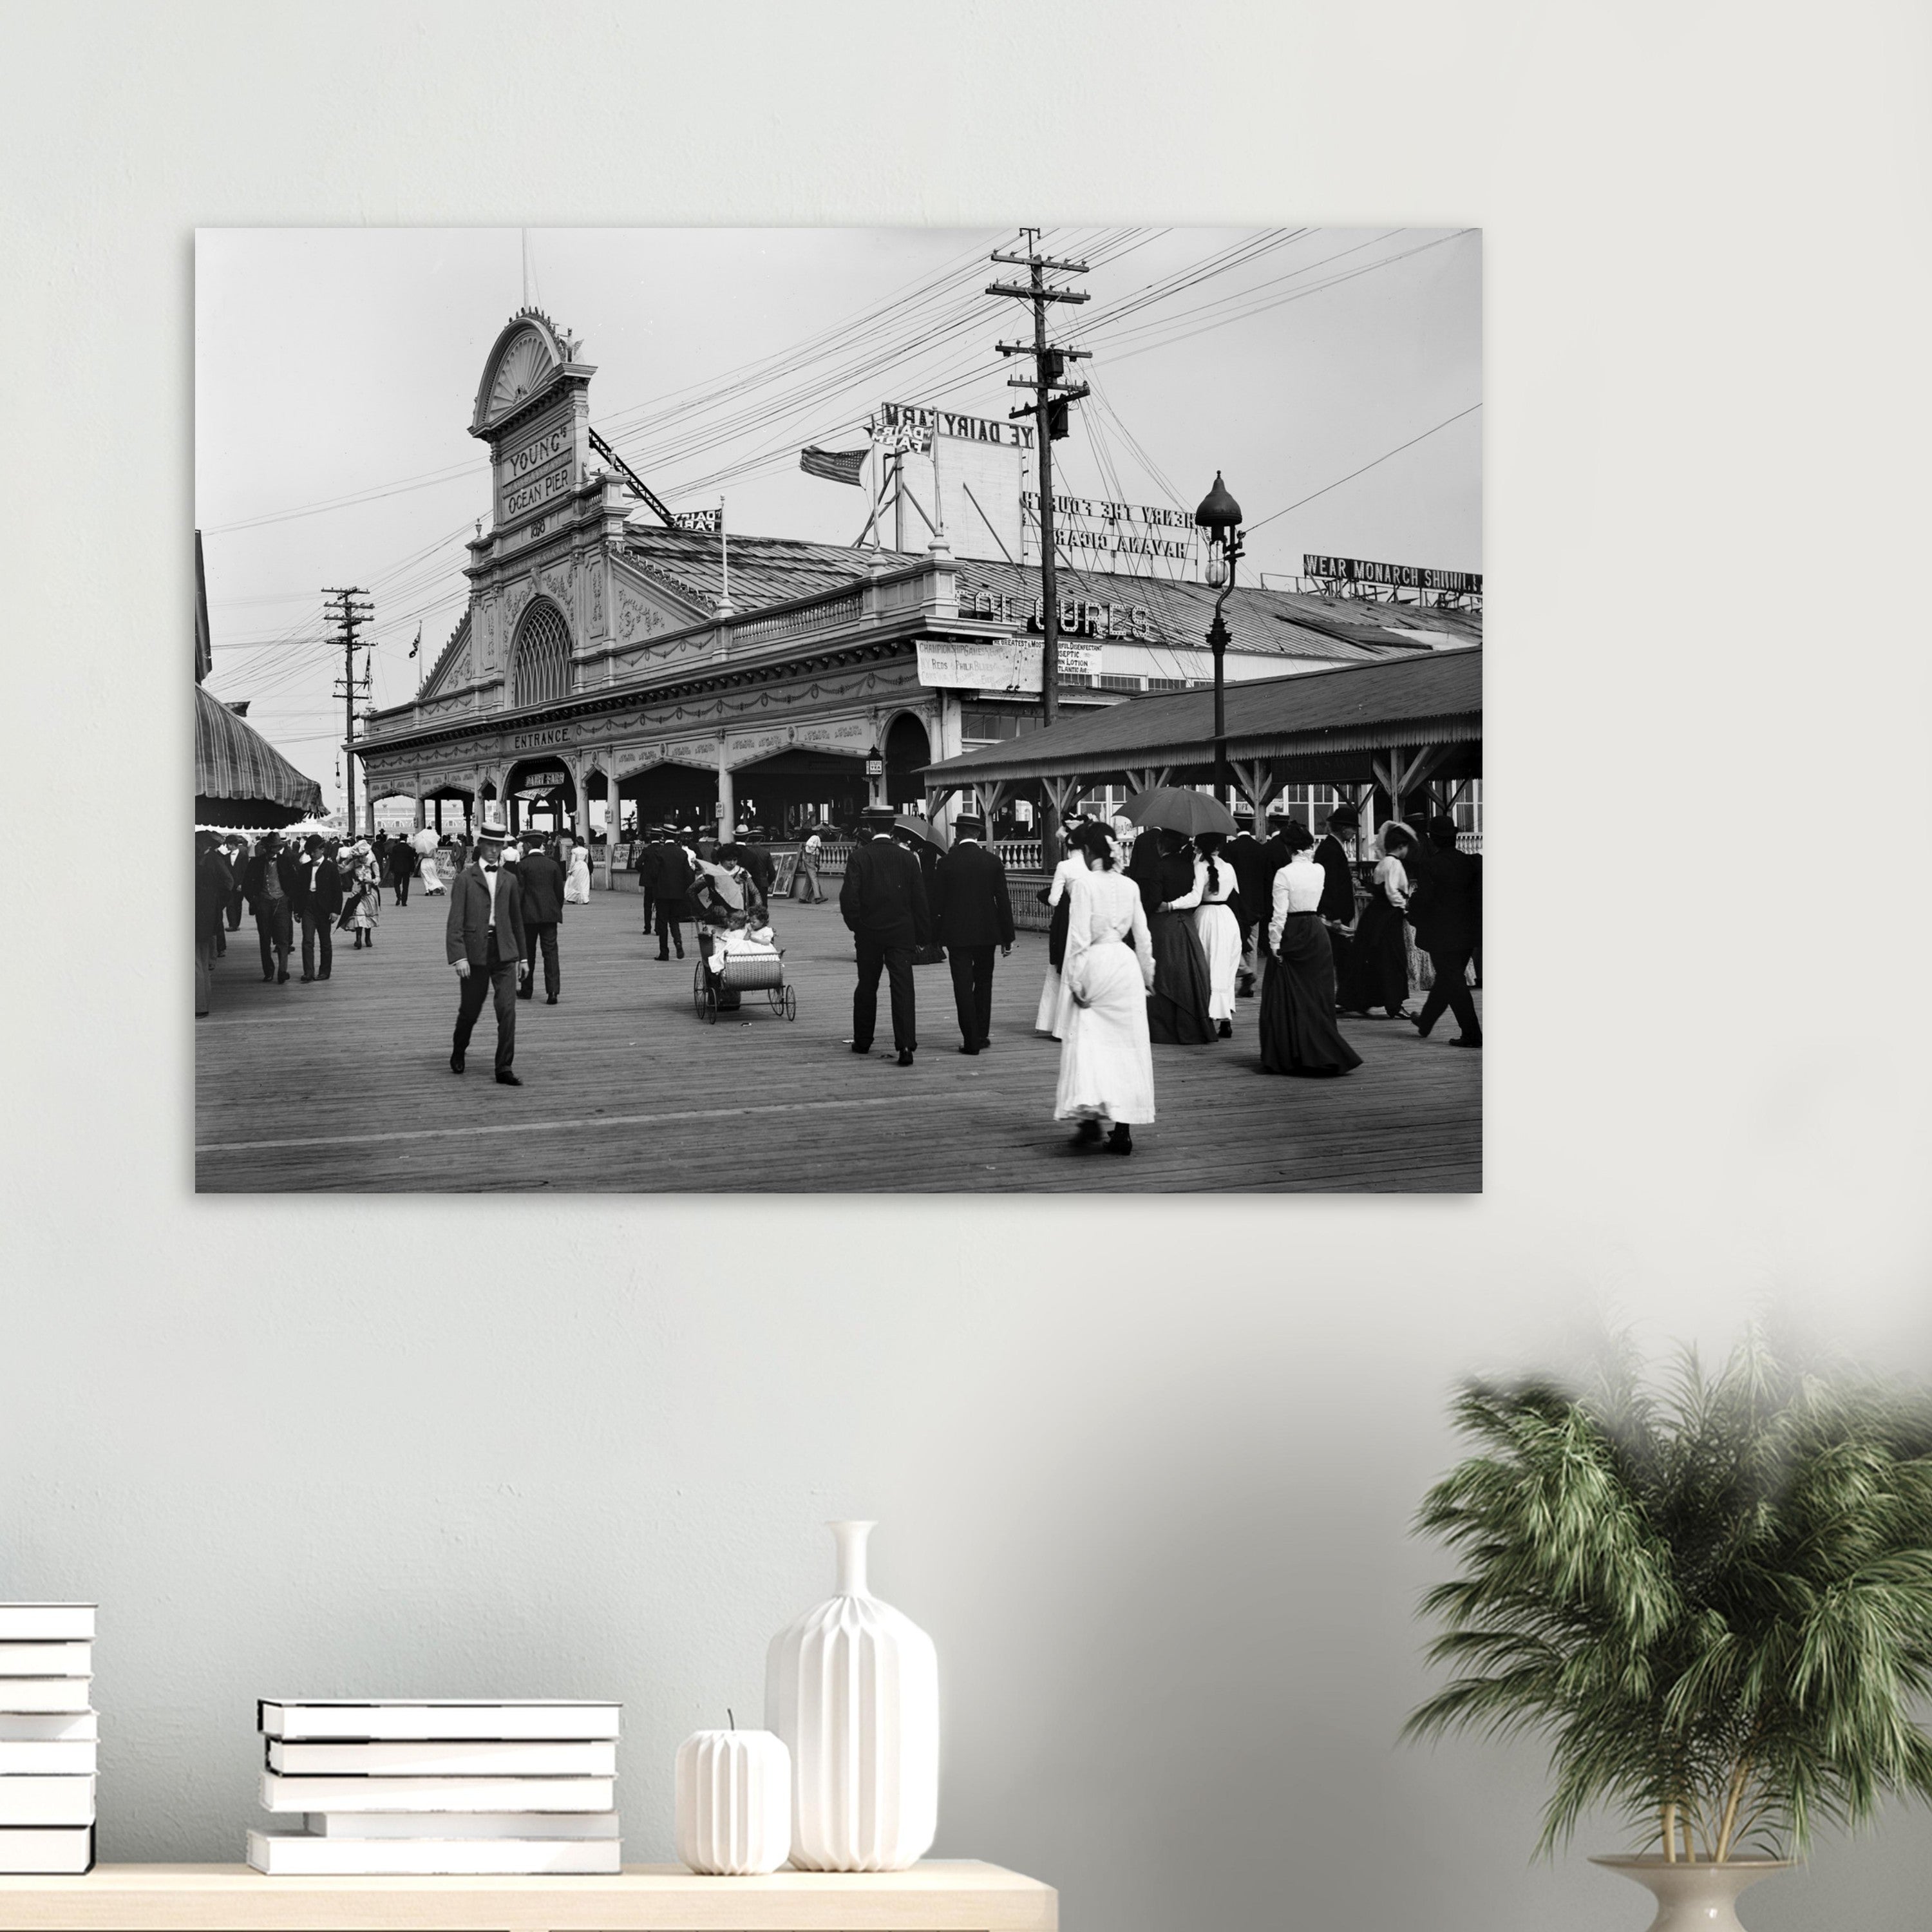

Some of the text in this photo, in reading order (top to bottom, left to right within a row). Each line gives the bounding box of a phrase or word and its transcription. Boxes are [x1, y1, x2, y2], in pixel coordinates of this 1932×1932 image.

[509, 469, 568, 514] OCEAN PIER
[1306, 555, 1347, 577] WEAR
[1354, 560, 1418, 586] MONARCH
[1066, 658, 1088, 667] LOTION
